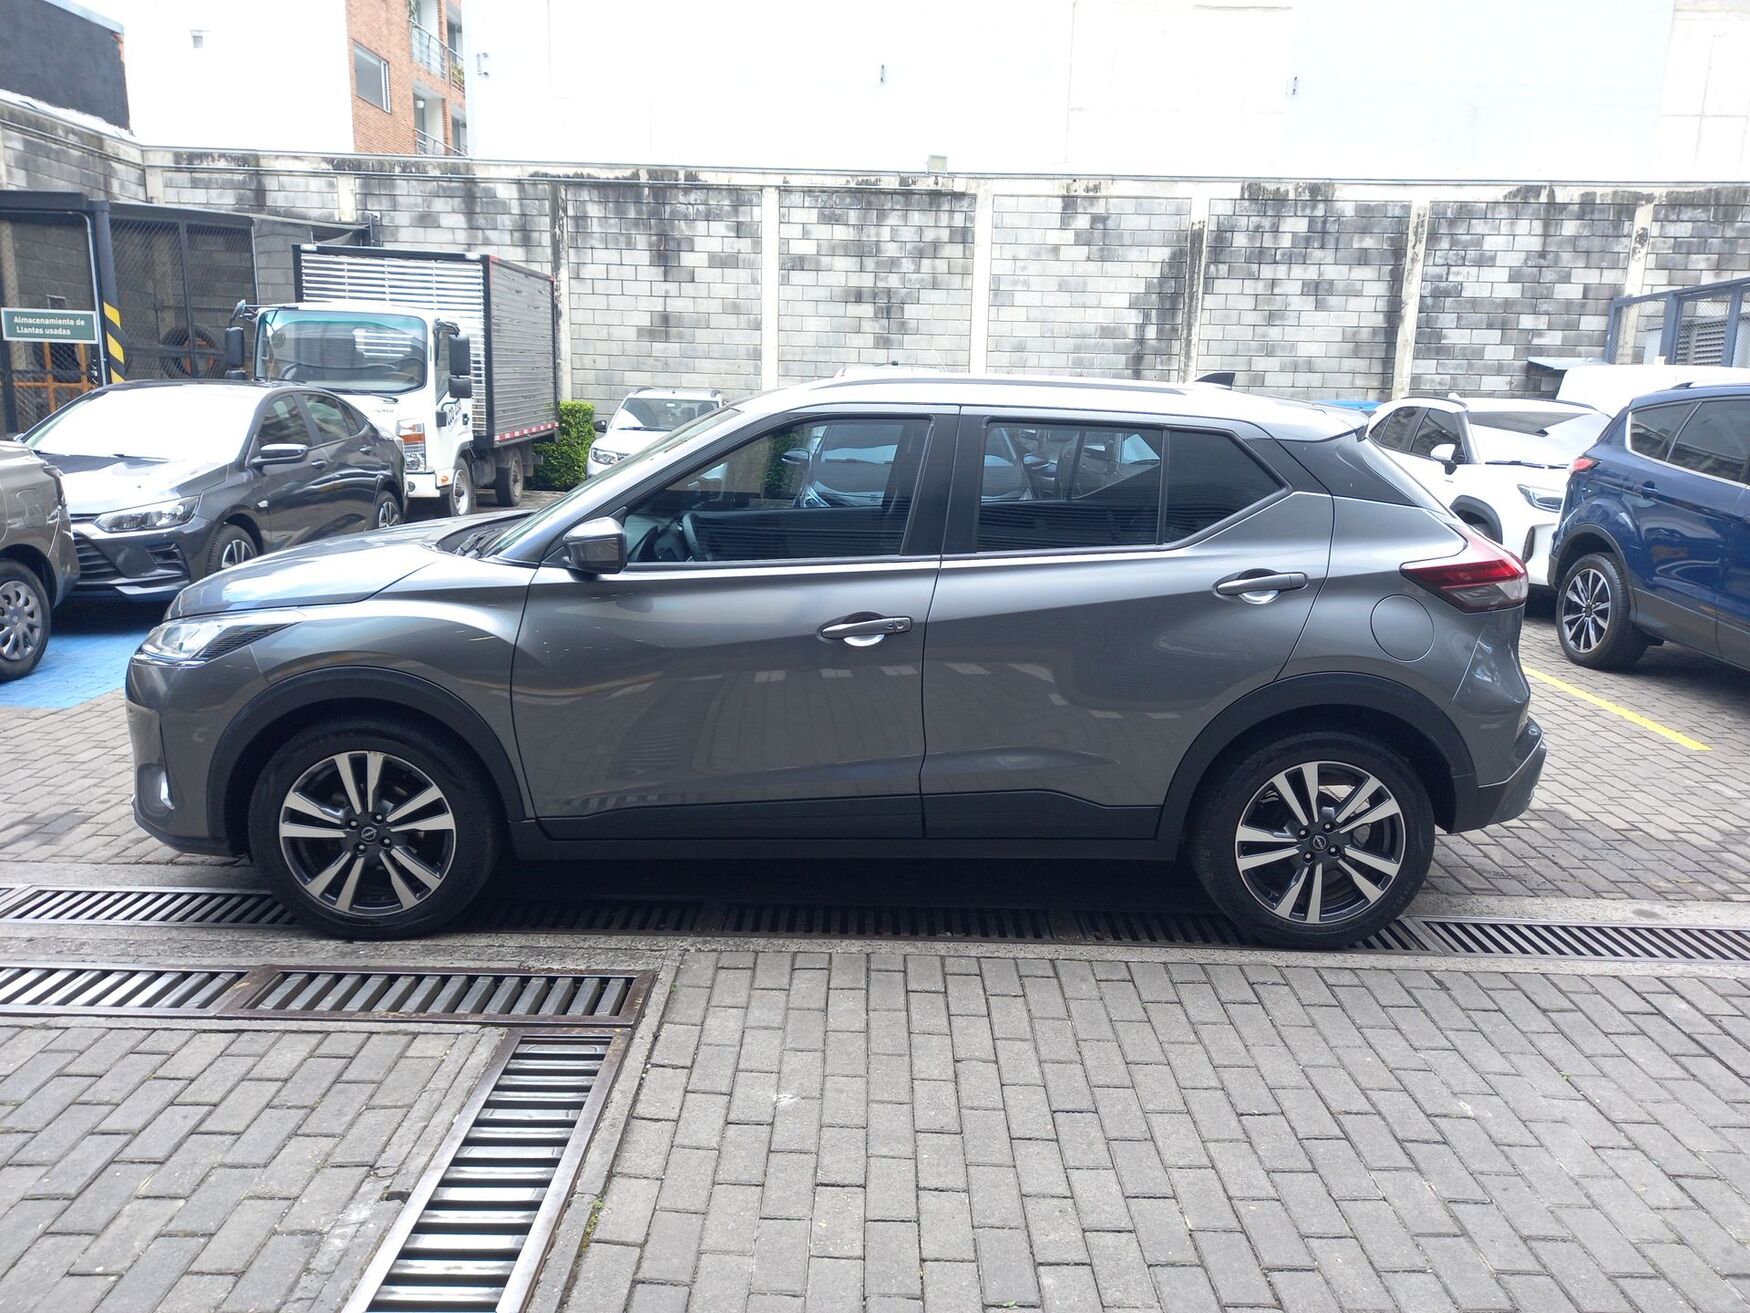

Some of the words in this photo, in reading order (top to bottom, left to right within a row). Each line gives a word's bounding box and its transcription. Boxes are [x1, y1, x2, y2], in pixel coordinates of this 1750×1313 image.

[13, 315, 75, 326] Almacenamiento
[75, 317, 86, 326] de
[16, 326, 44, 334] Llantas
[44, 327, 71, 335] usadas
